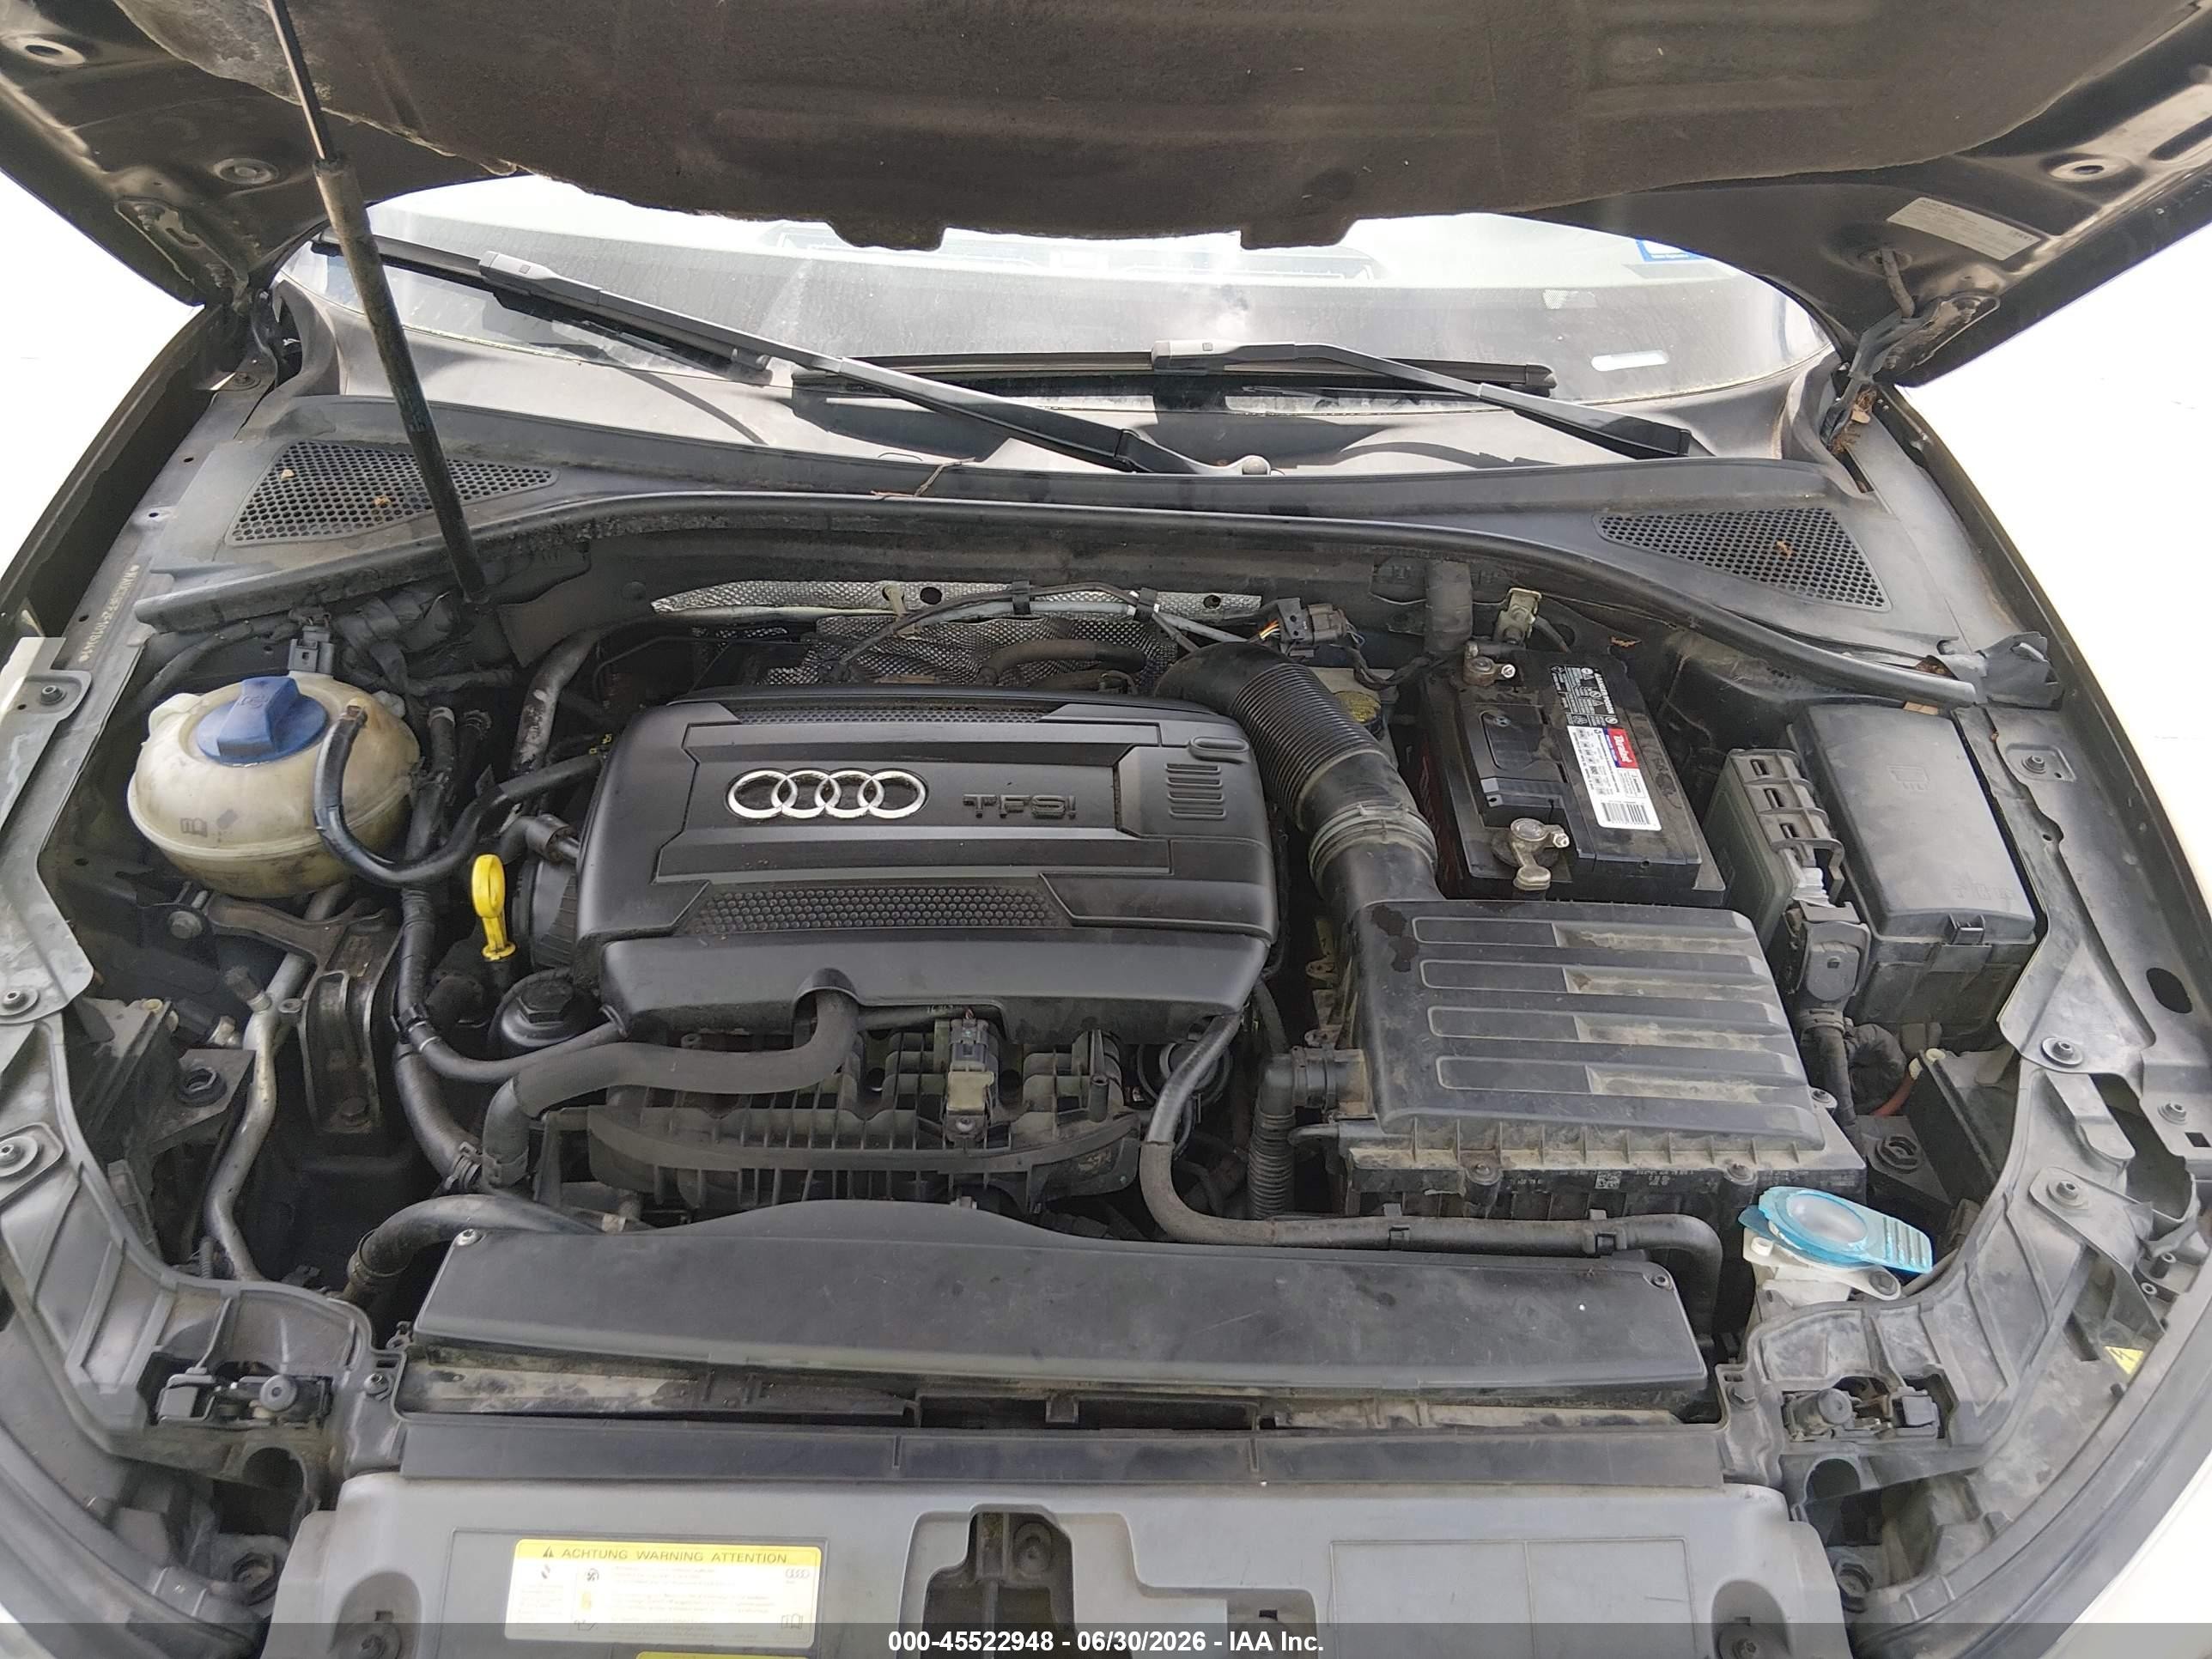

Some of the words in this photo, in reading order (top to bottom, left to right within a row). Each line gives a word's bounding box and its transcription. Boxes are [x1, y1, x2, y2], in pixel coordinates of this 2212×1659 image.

[963, 793, 1077, 819] TFSI
[562, 1548, 629, 1560] ACHTUNG
[636, 1550, 704, 1562] WARNING
[711, 1552, 787, 1565] ATTENTION
